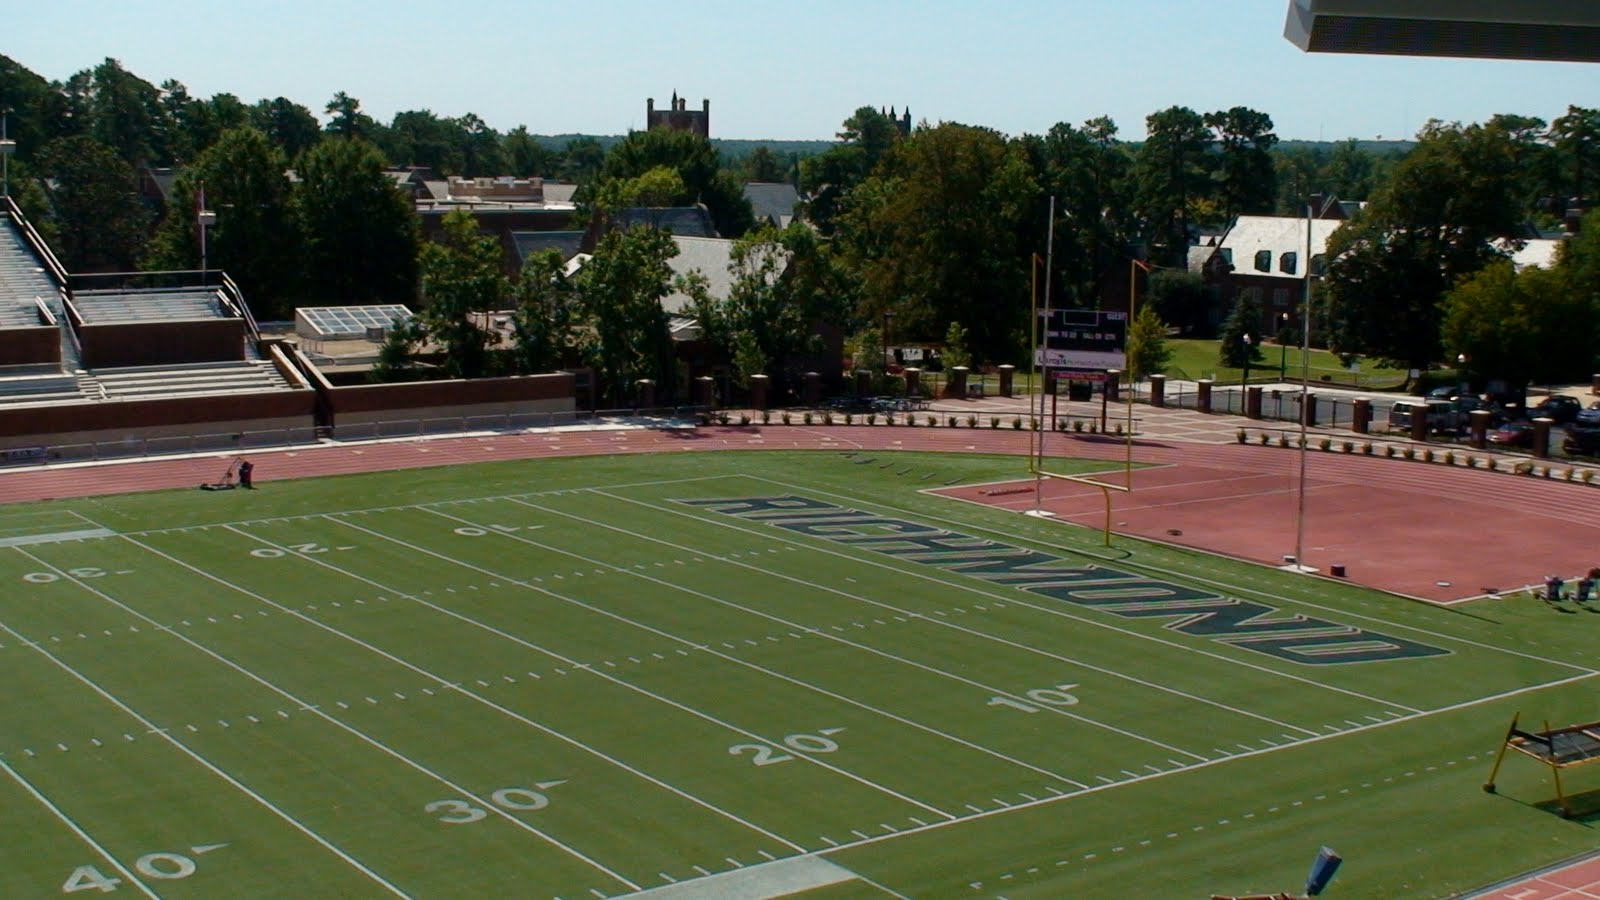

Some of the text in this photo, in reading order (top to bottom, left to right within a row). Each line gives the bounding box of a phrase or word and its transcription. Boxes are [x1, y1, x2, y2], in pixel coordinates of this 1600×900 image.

[665, 492, 1455, 667] RICHMOND
[987, 687, 1080, 714] 10
[728, 732, 840, 767] 20
[423, 787, 550, 825] 30
[62, 851, 197, 895] 40
